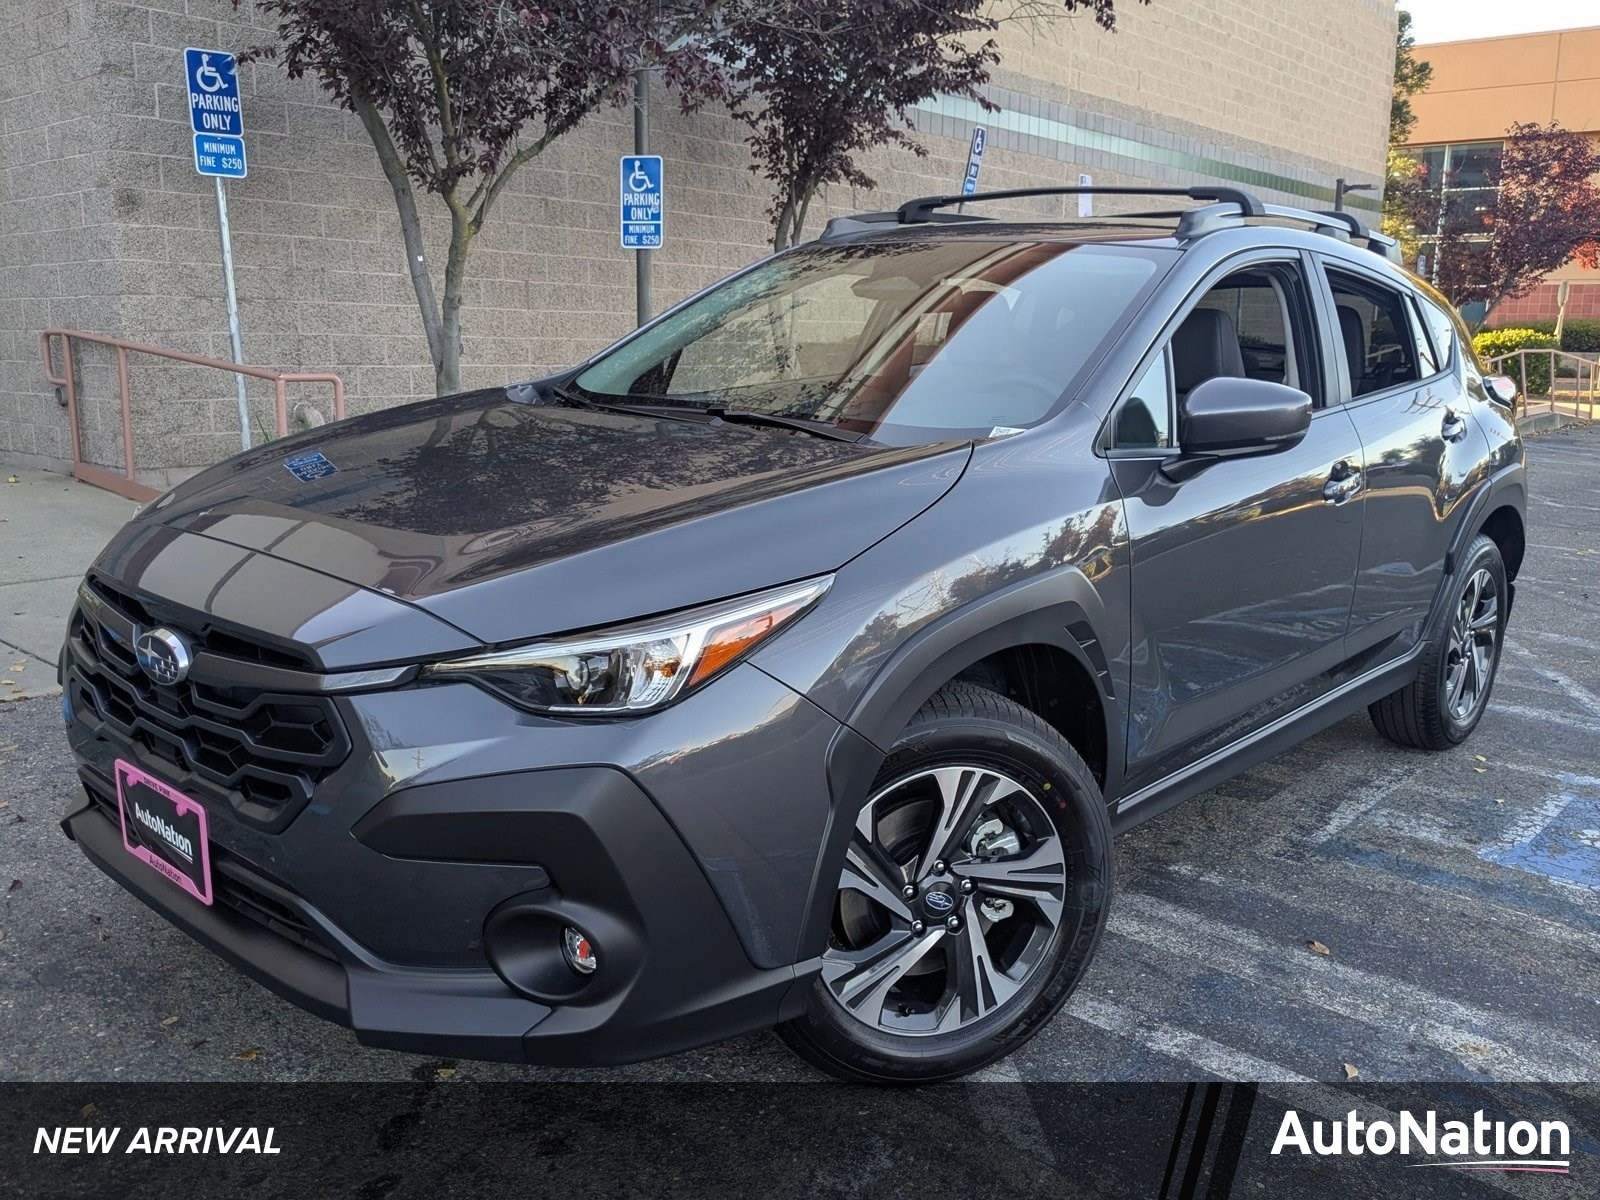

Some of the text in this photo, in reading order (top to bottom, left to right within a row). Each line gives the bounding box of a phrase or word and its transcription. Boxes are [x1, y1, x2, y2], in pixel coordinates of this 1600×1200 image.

[191, 93, 239, 112] PARKING
[202, 113, 231, 131] ONLY
[203, 142, 236, 155] MINIMUM
[200, 155, 242, 170] FINE $250
[624, 193, 660, 206] PARKING
[631, 207, 653, 220] ONLY
[629, 224, 655, 234] MINIMUM
[625, 235, 660, 245] FINE $250
[135, 802, 193, 856] AutoNation
[150, 855, 182, 883] AutoNation
